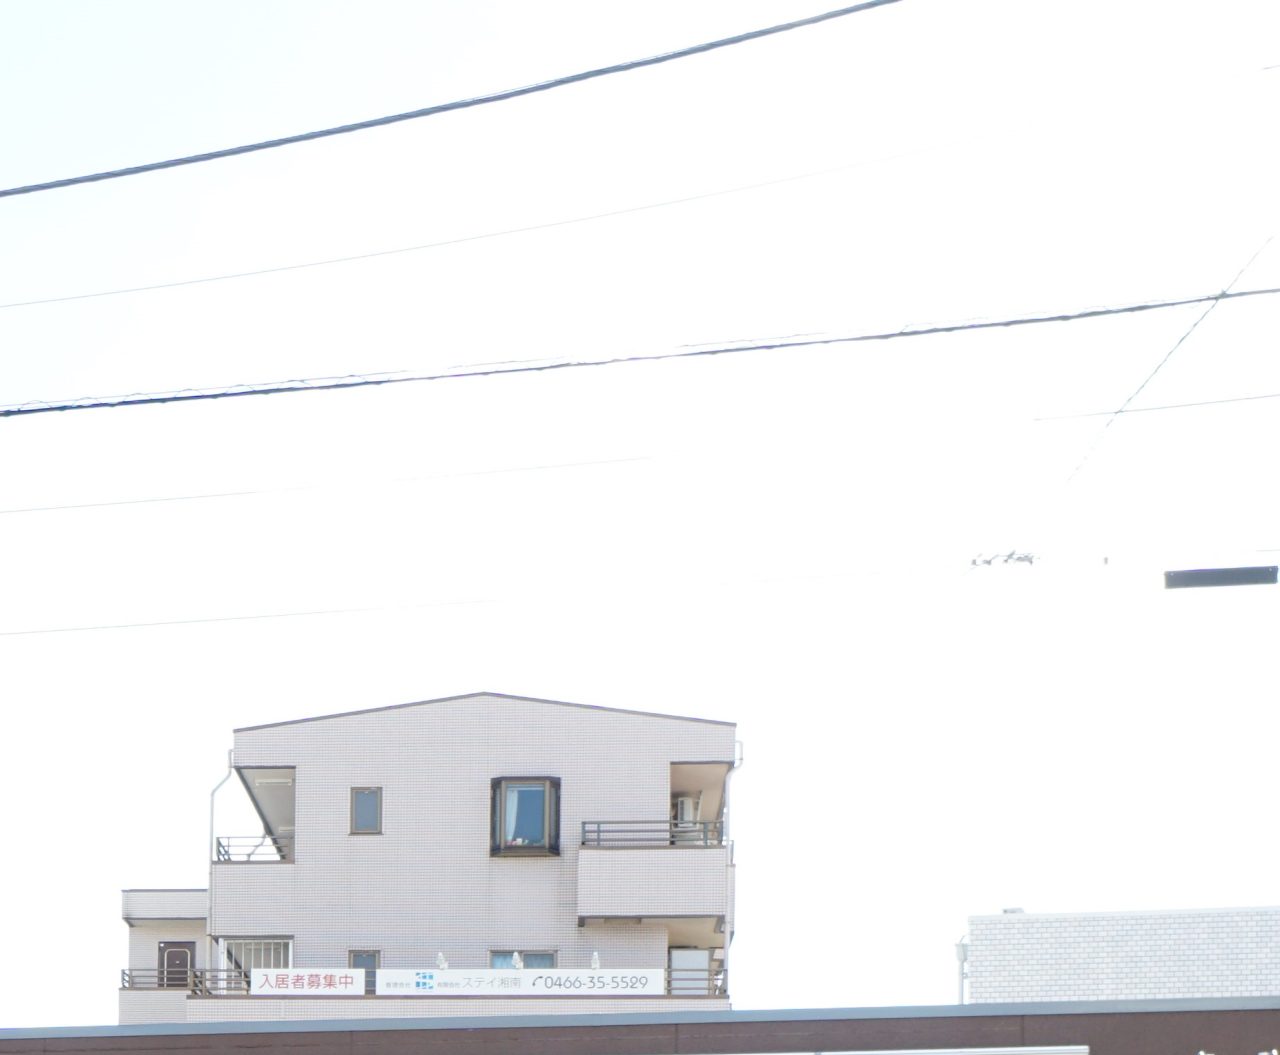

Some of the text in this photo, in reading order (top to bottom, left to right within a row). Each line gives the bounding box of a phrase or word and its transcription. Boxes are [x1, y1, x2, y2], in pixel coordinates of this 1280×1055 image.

[259, 974, 354, 989] 入居者募集中
[544, 976, 648, 989] 0466-35-5529
